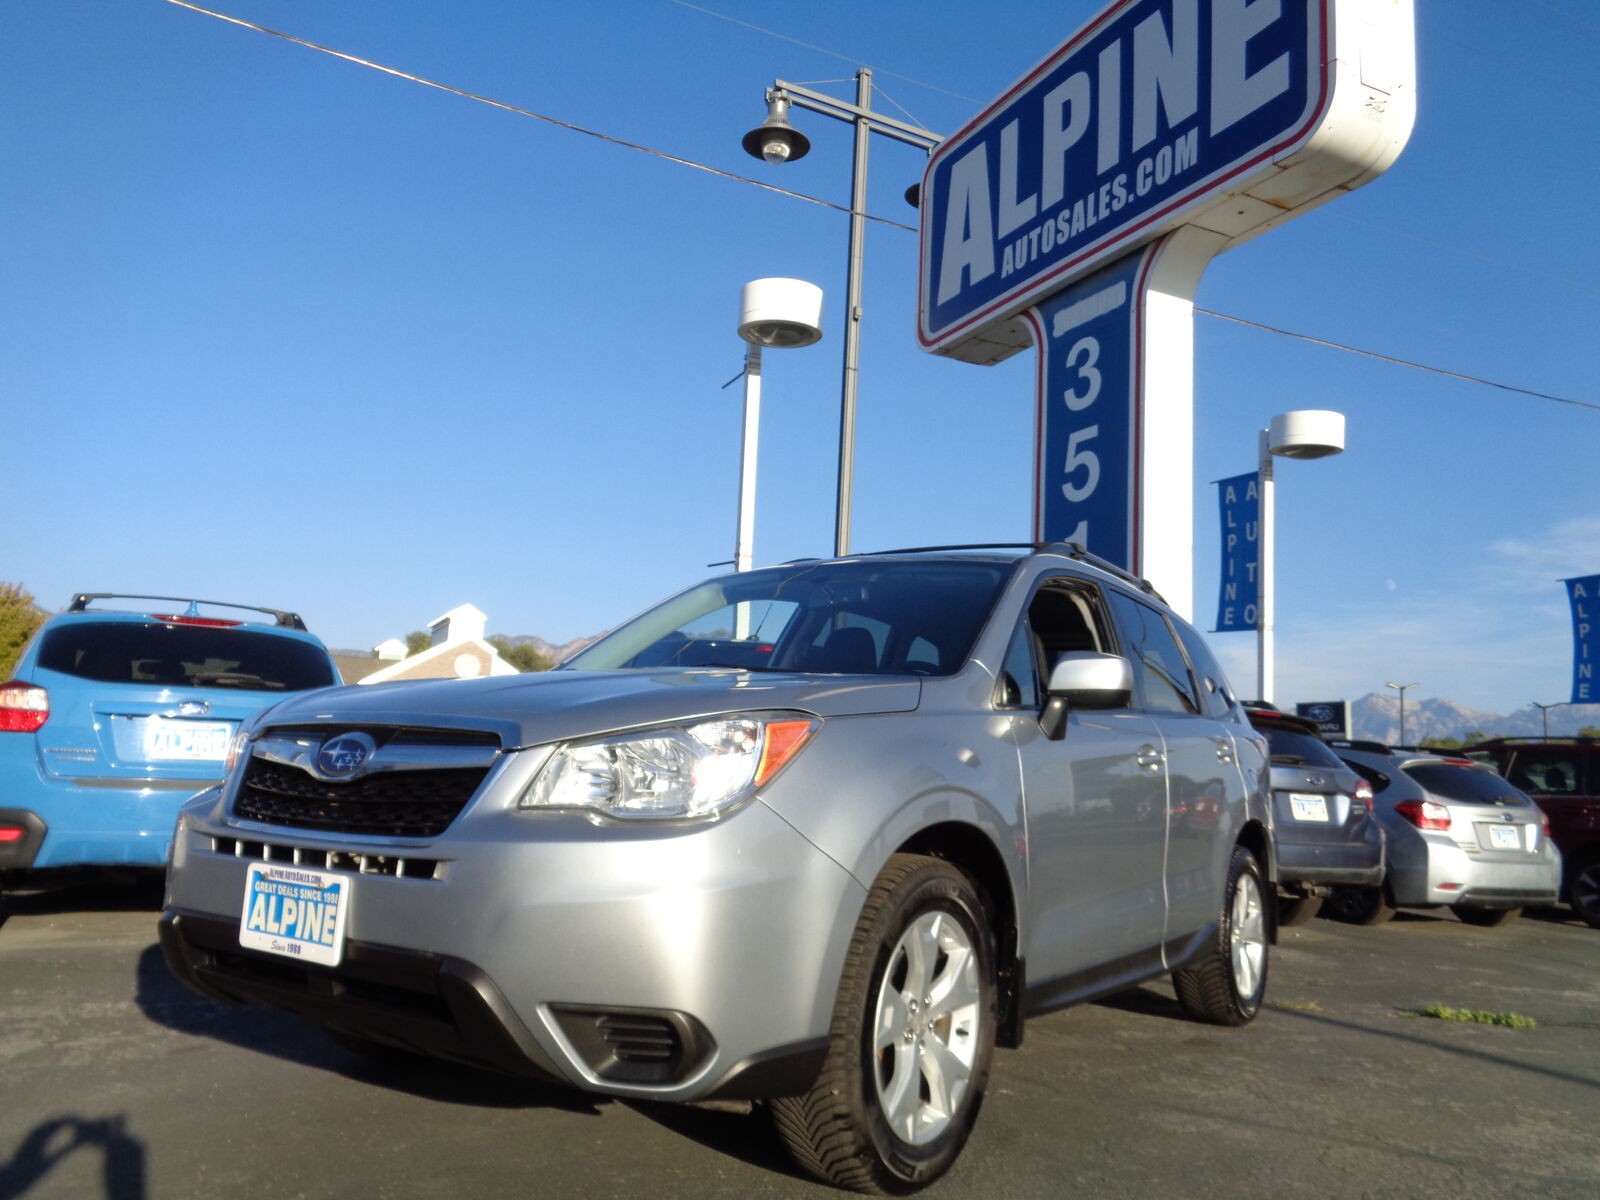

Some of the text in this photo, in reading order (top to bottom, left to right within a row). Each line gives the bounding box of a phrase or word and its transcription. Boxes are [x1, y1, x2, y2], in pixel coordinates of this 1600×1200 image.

[937, 0, 1290, 305] ALPINE
[1001, 126, 1198, 279] AUTOSALES.COM
[1223, 485, 1237, 625] ALPINE
[1244, 480, 1258, 624] AUTO
[1574, 583, 1592, 699] ALPINE
[248, 893, 337, 944] ALPINE
[255, 881, 277, 895] GREAT
[277, 884, 298, 898] DEALS
[300, 888, 322, 901] SINCE
